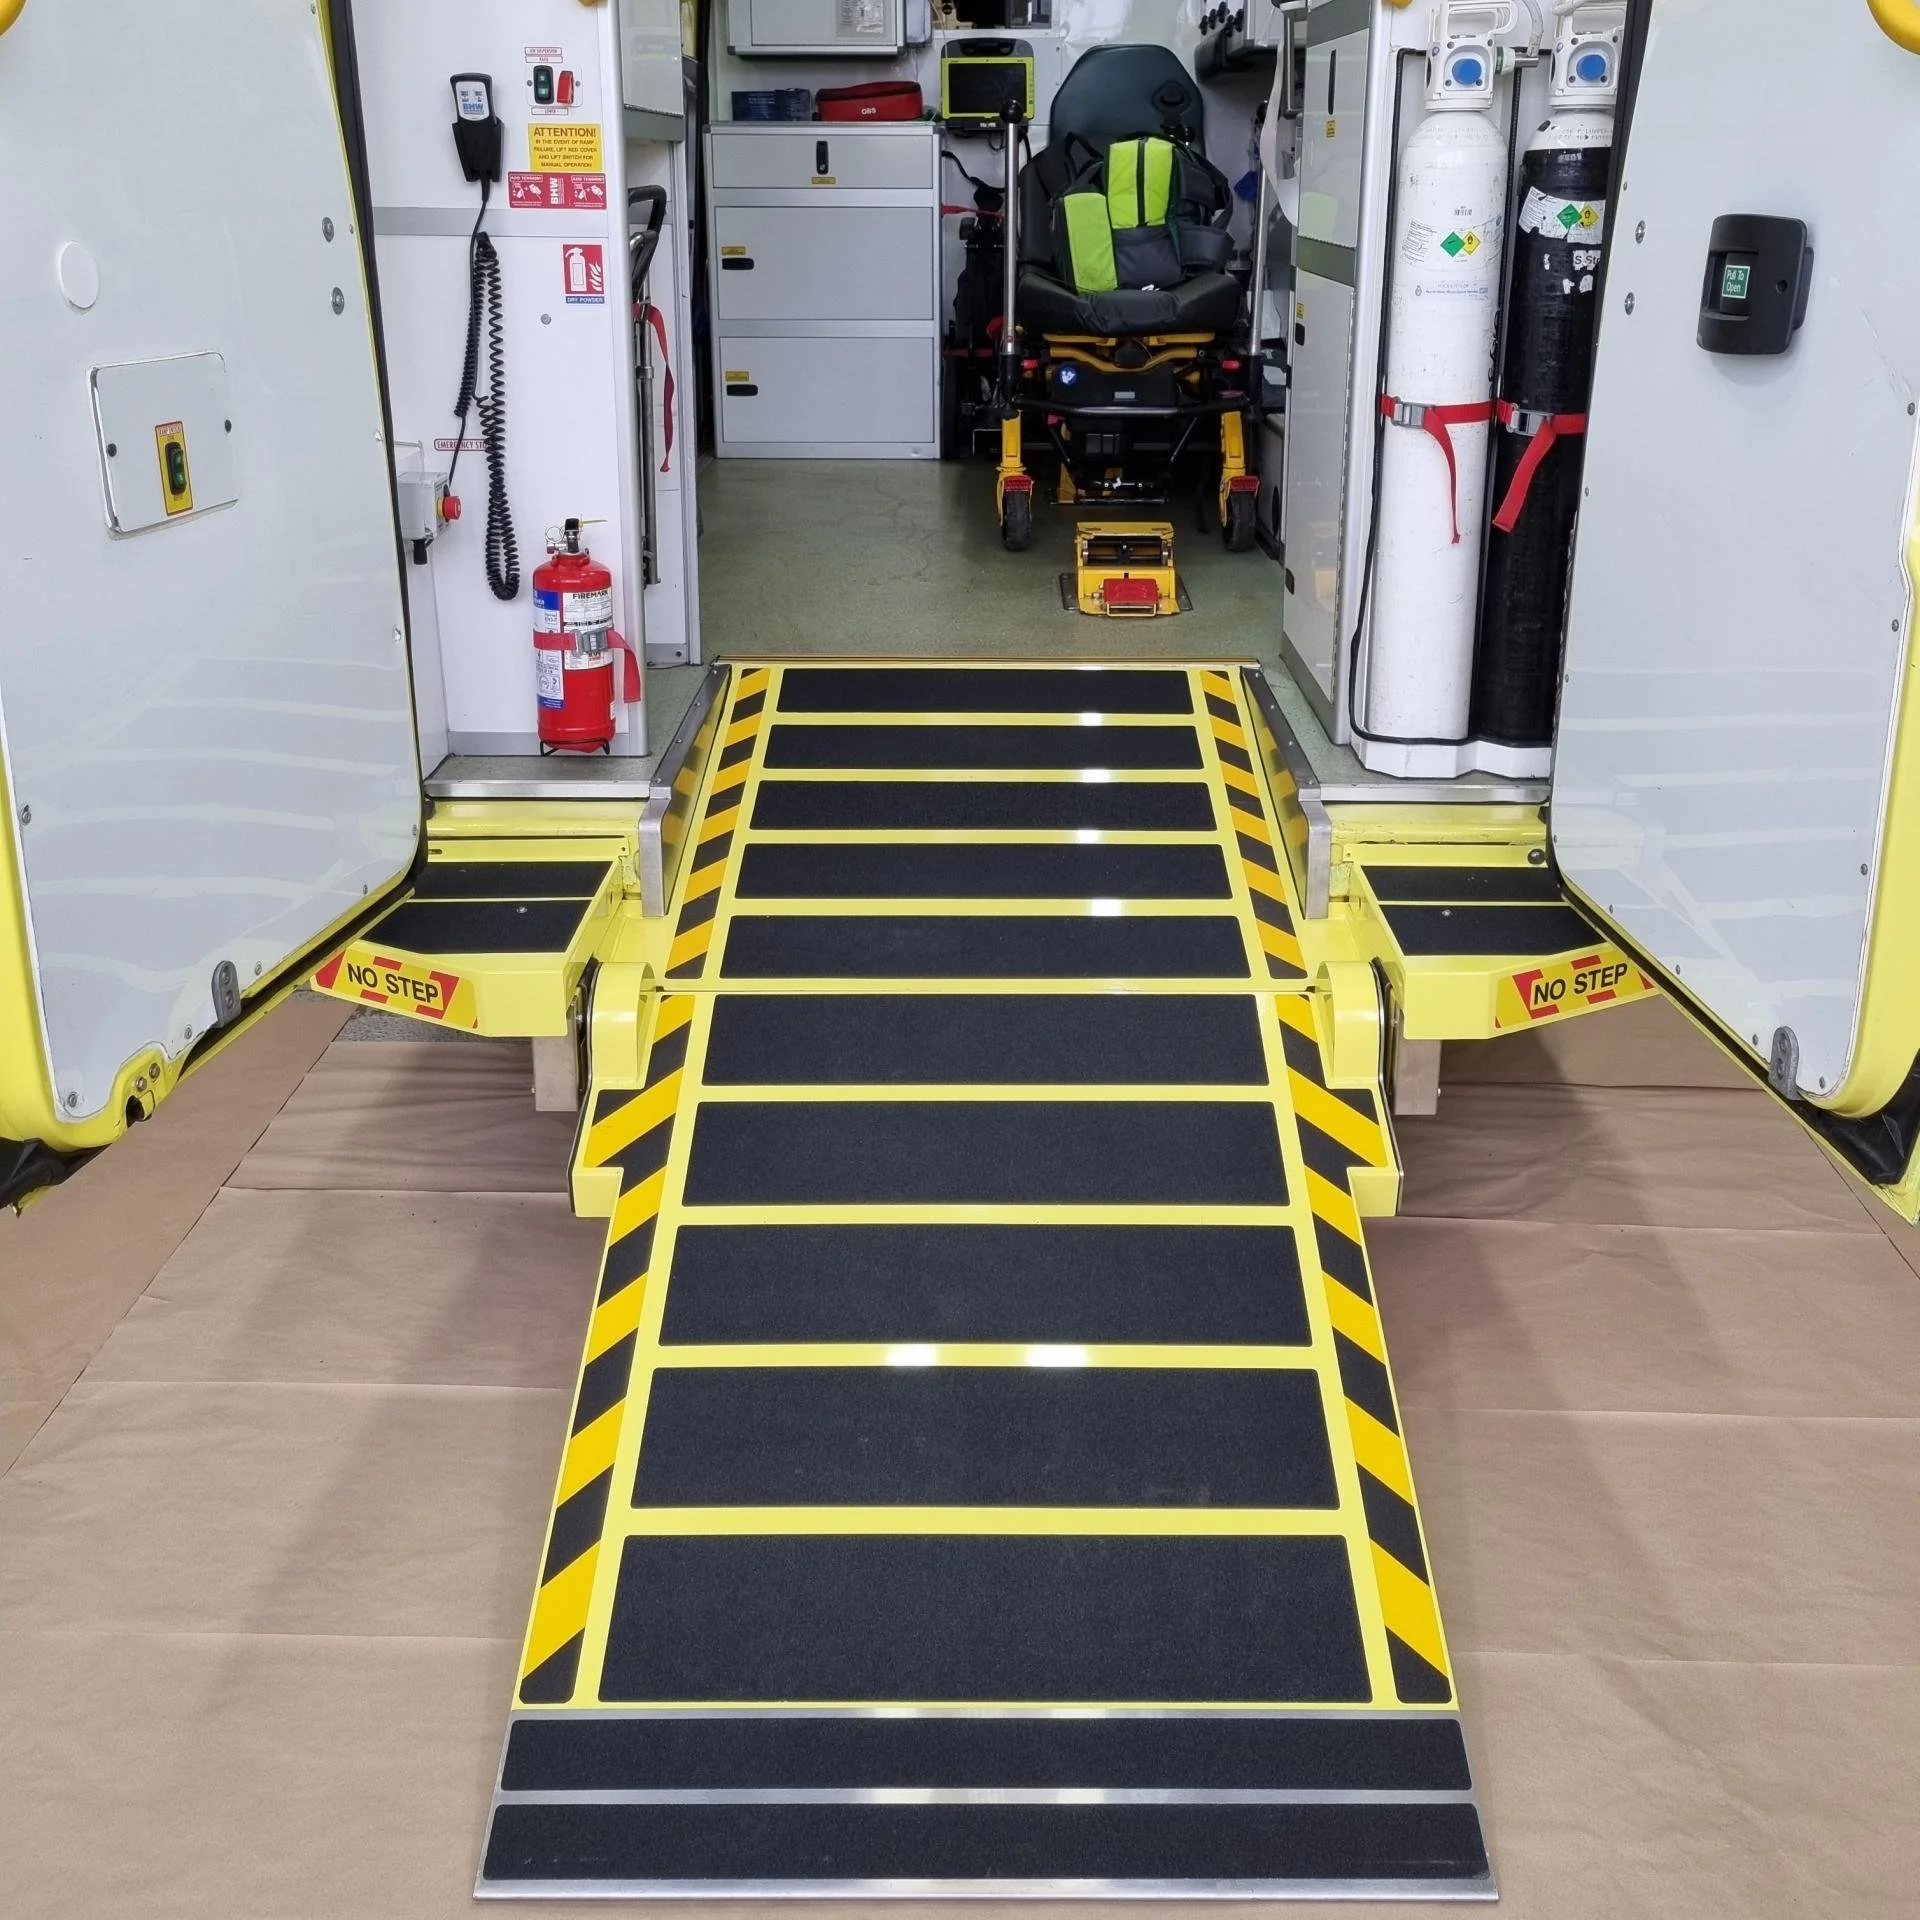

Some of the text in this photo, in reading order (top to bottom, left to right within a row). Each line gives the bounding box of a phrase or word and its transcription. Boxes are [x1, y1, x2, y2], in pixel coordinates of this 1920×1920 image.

[534, 127, 596, 138] ATTENTION!
[549, 177, 559, 204] BHW
[1726, 269, 1745, 281] Pull To
[1726, 283, 1741, 294] Open
[436, 440, 474, 449] EMERGNCY
[572, 589, 608, 599] FIREMARK
[347, 963, 440, 1003] NO STEP
[1533, 962, 1629, 1005] NO STEP
